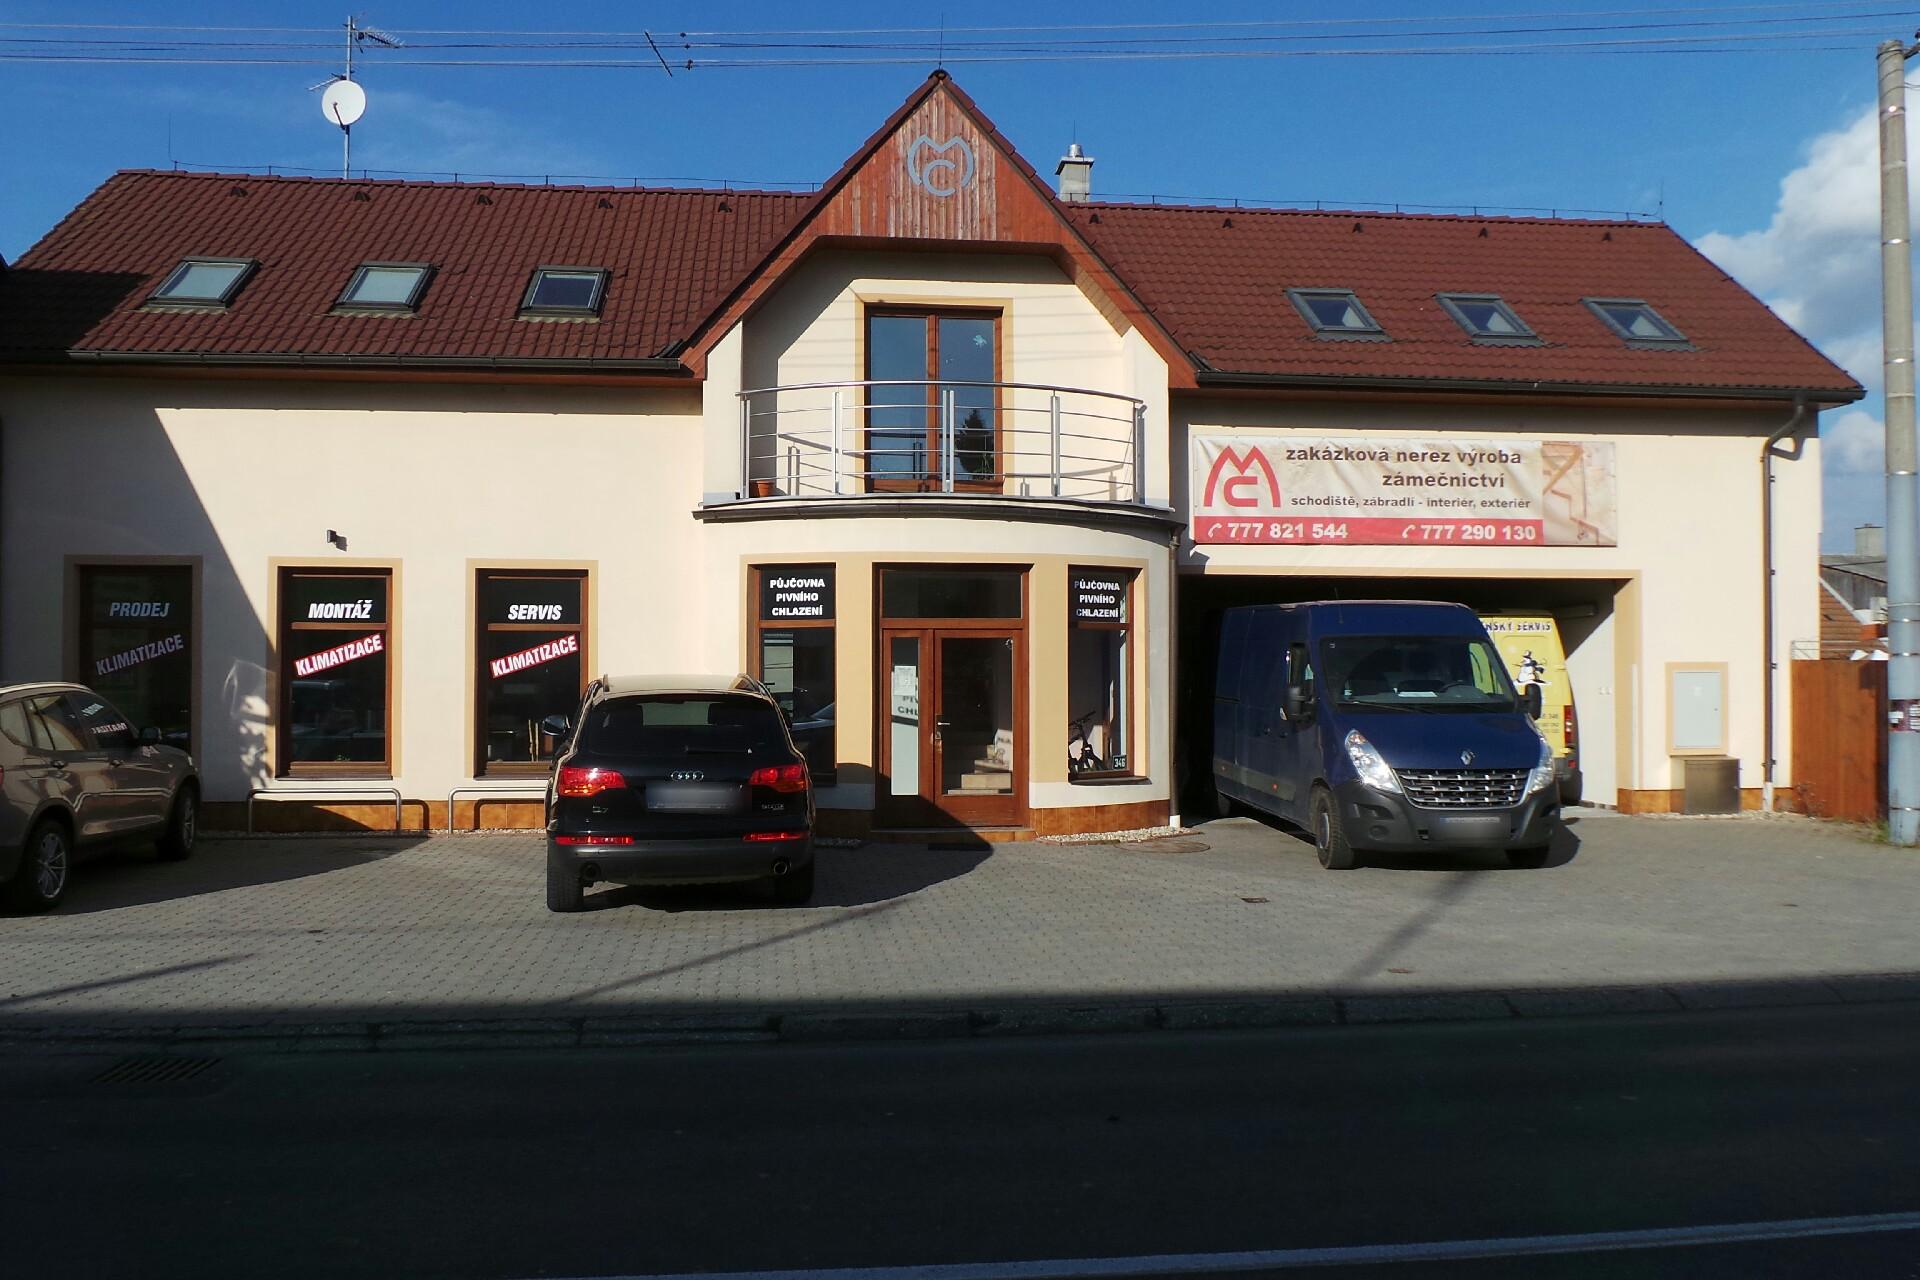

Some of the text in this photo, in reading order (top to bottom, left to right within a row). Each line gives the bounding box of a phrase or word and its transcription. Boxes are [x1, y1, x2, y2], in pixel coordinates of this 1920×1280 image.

[1286, 447, 1521, 466] zakázková nerez výroba
[1382, 471, 1505, 488] zámečnictví
[1291, 496, 1360, 508] schodiště,
[1363, 497, 1414, 507] zábradlí
[1480, 498, 1531, 508] exteriér
[1227, 522, 1349, 539] 777 821 544
[1420, 525, 1536, 540] 777 290 130
[769, 577, 826, 589] PŮJČOVNA
[1074, 578, 1121, 591] PŮJČOVNA
[775, 590, 819, 602] PIVNÍHO
[1079, 593, 1116, 604] PIVNÍHO
[109, 602, 170, 617] PRODEJ
[307, 599, 373, 619] MONTÁŽ
[507, 604, 563, 621] SERVIS
[771, 604, 824, 616] CHLAZENÍ
[1076, 607, 1119, 618] CHLAZENÍ
[96, 634, 184, 676] KLIMATIZACE
[295, 633, 383, 677] KLIMATIZACE
[492, 634, 578, 677] KLIMATIZACE
[1114, 758, 1126, 768] 346
